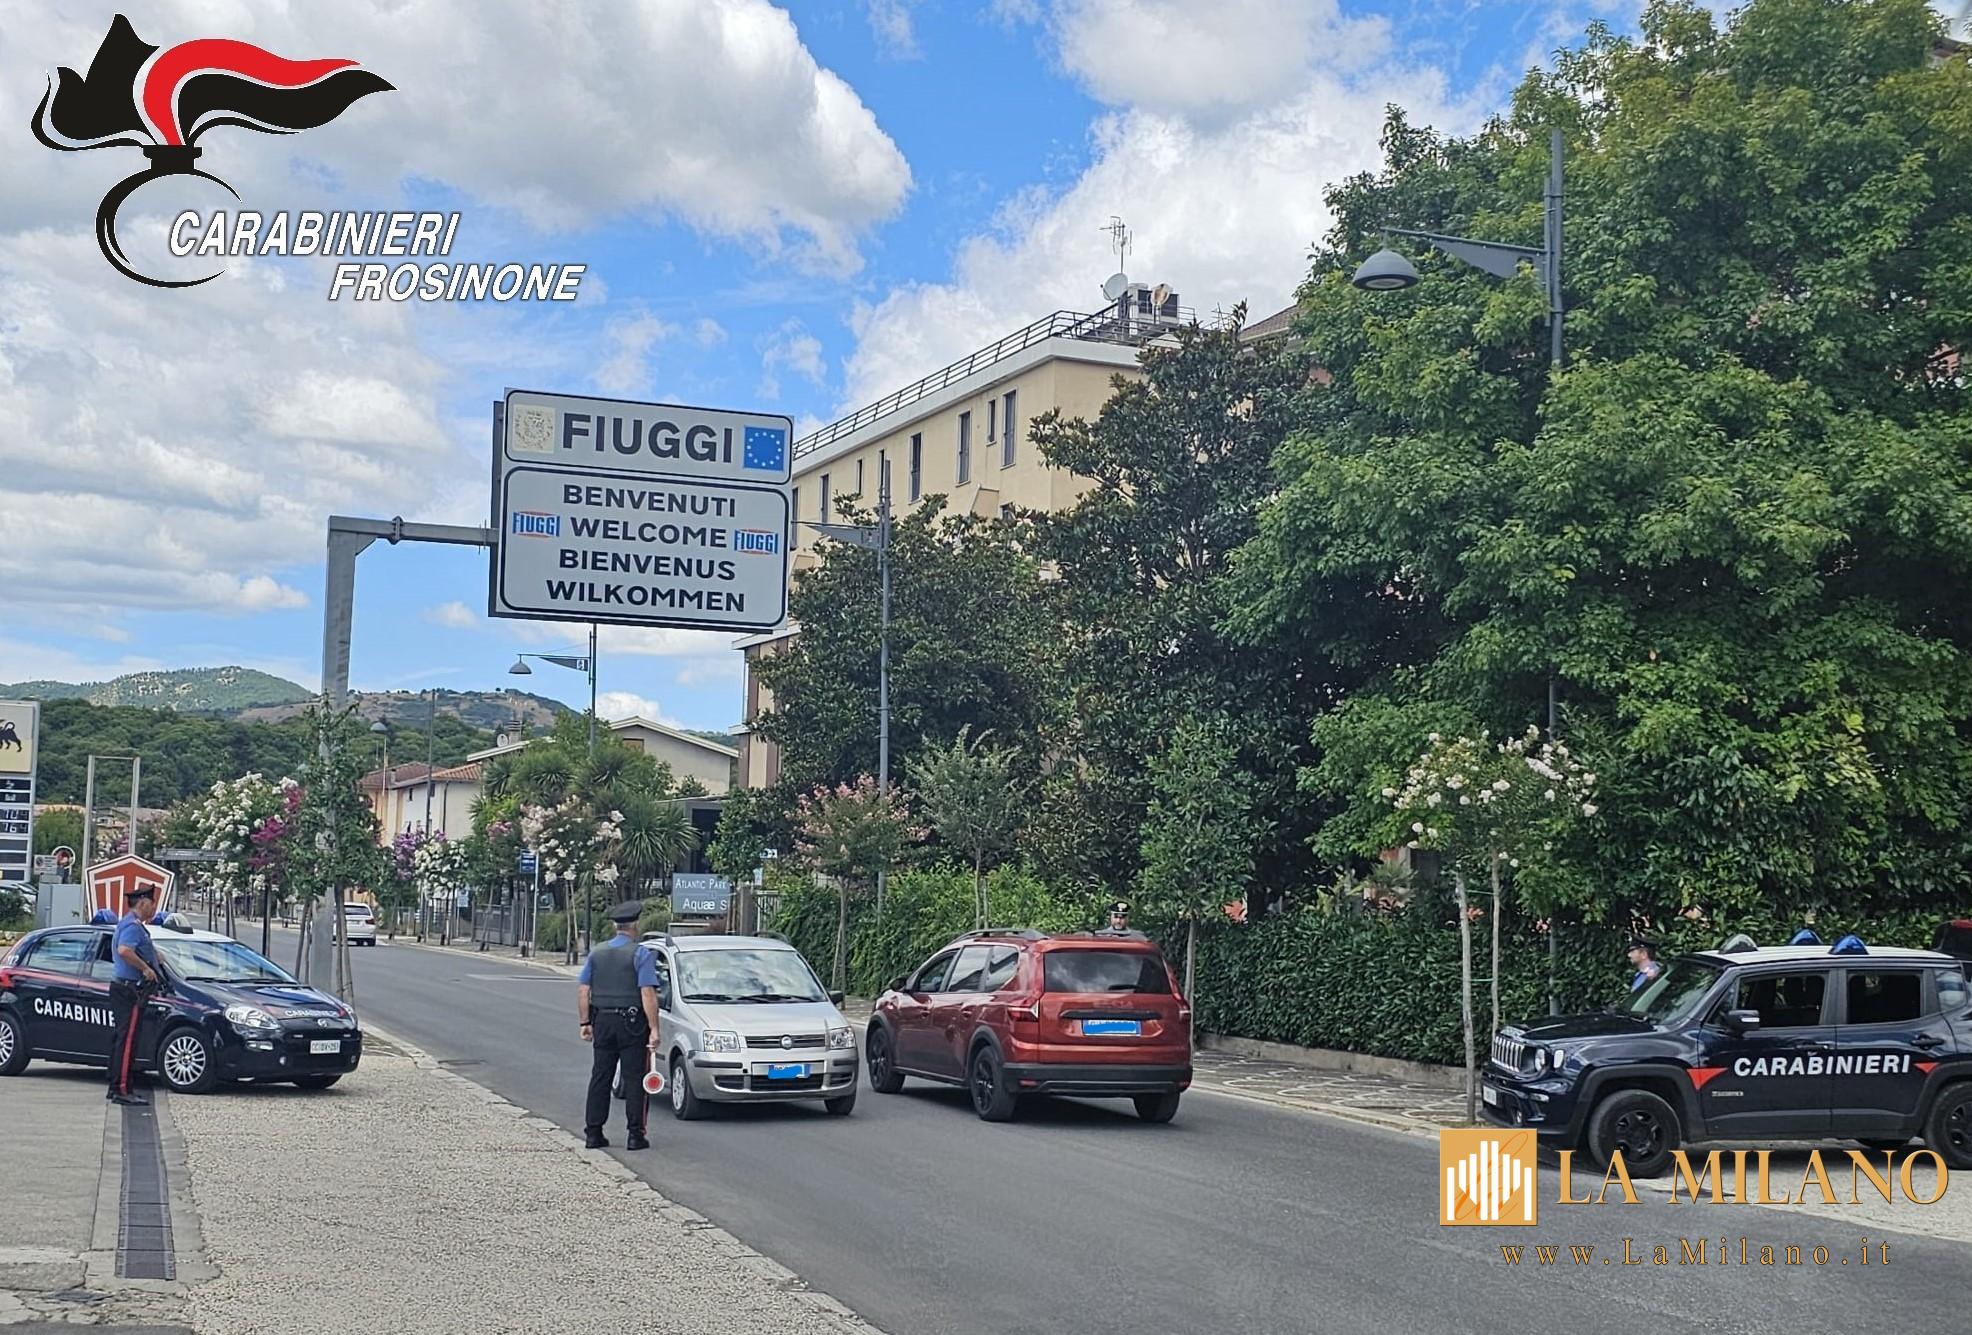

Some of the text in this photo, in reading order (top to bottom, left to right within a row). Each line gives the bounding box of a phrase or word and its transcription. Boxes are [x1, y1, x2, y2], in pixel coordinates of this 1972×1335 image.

[562, 412, 733, 464] FIUGGI
[563, 484, 736, 517] BENVENUTI
[512, 511, 561, 538] FIUGGI
[570, 516, 728, 548] WELCOME
[734, 528, 779, 555] FIUGGI
[559, 548, 736, 581] BIENVENUS
[546, 579, 745, 613] WILKOMMEN
[34, 997, 116, 1028] CARABINIE
[1733, 1053, 1911, 1078] CARABINIERI
